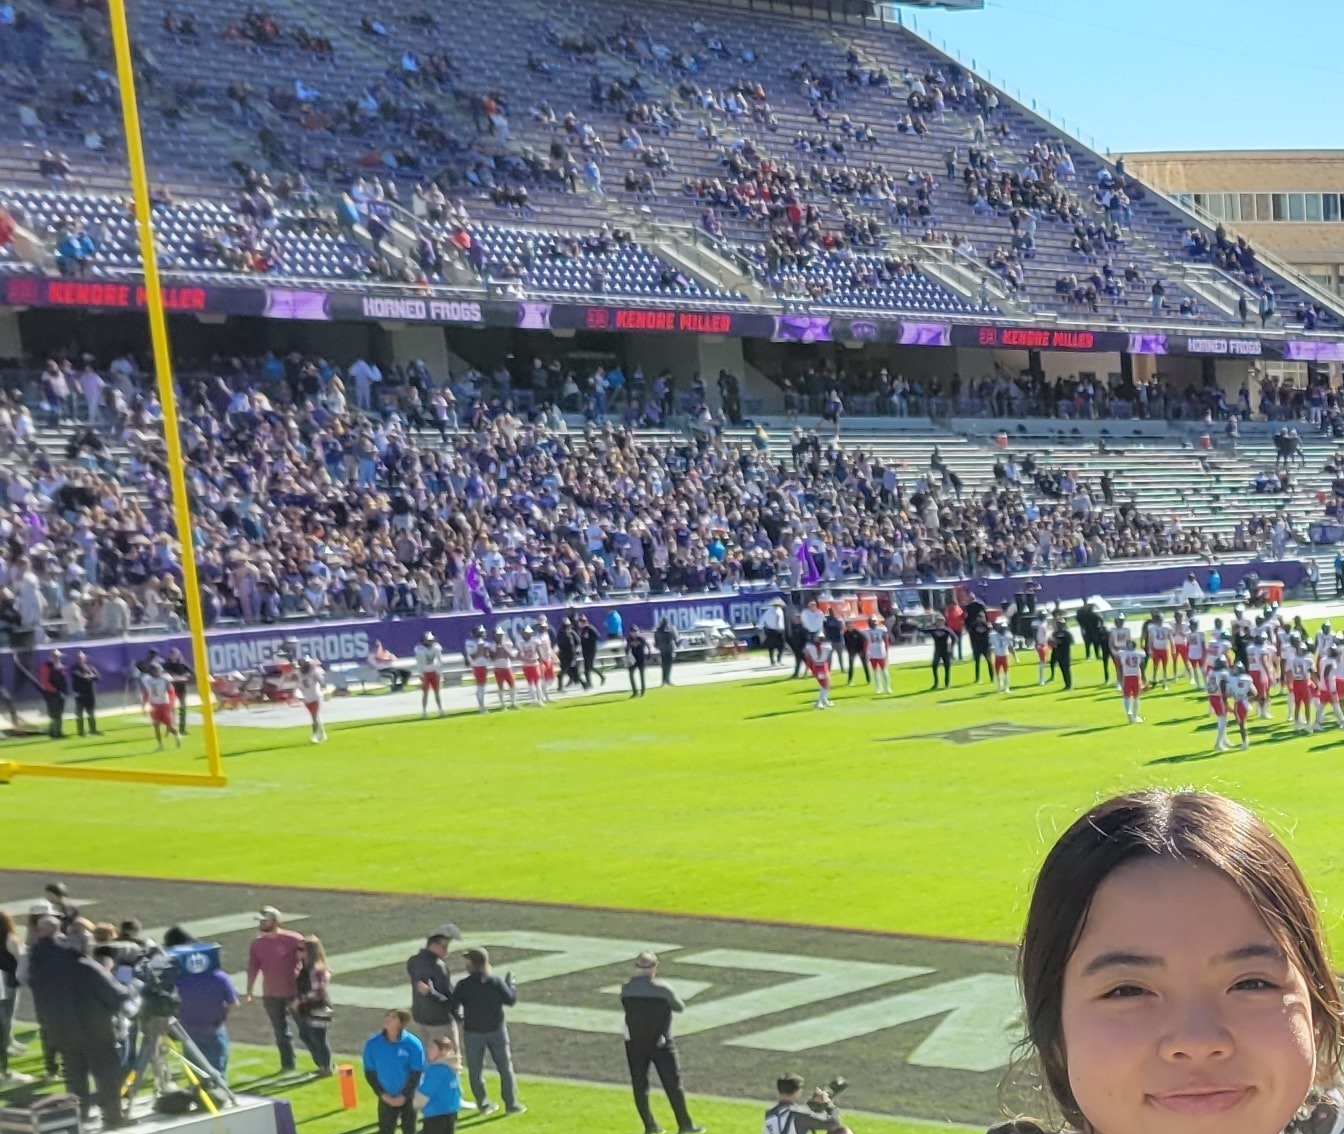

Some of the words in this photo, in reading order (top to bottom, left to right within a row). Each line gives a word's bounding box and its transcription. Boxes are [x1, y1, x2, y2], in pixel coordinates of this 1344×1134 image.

[363, 298, 427, 318] HORNED
[431, 301, 482, 321] FROGS
[616, 310, 674, 329] KENDRE
[680, 312, 731, 332] MILLER
